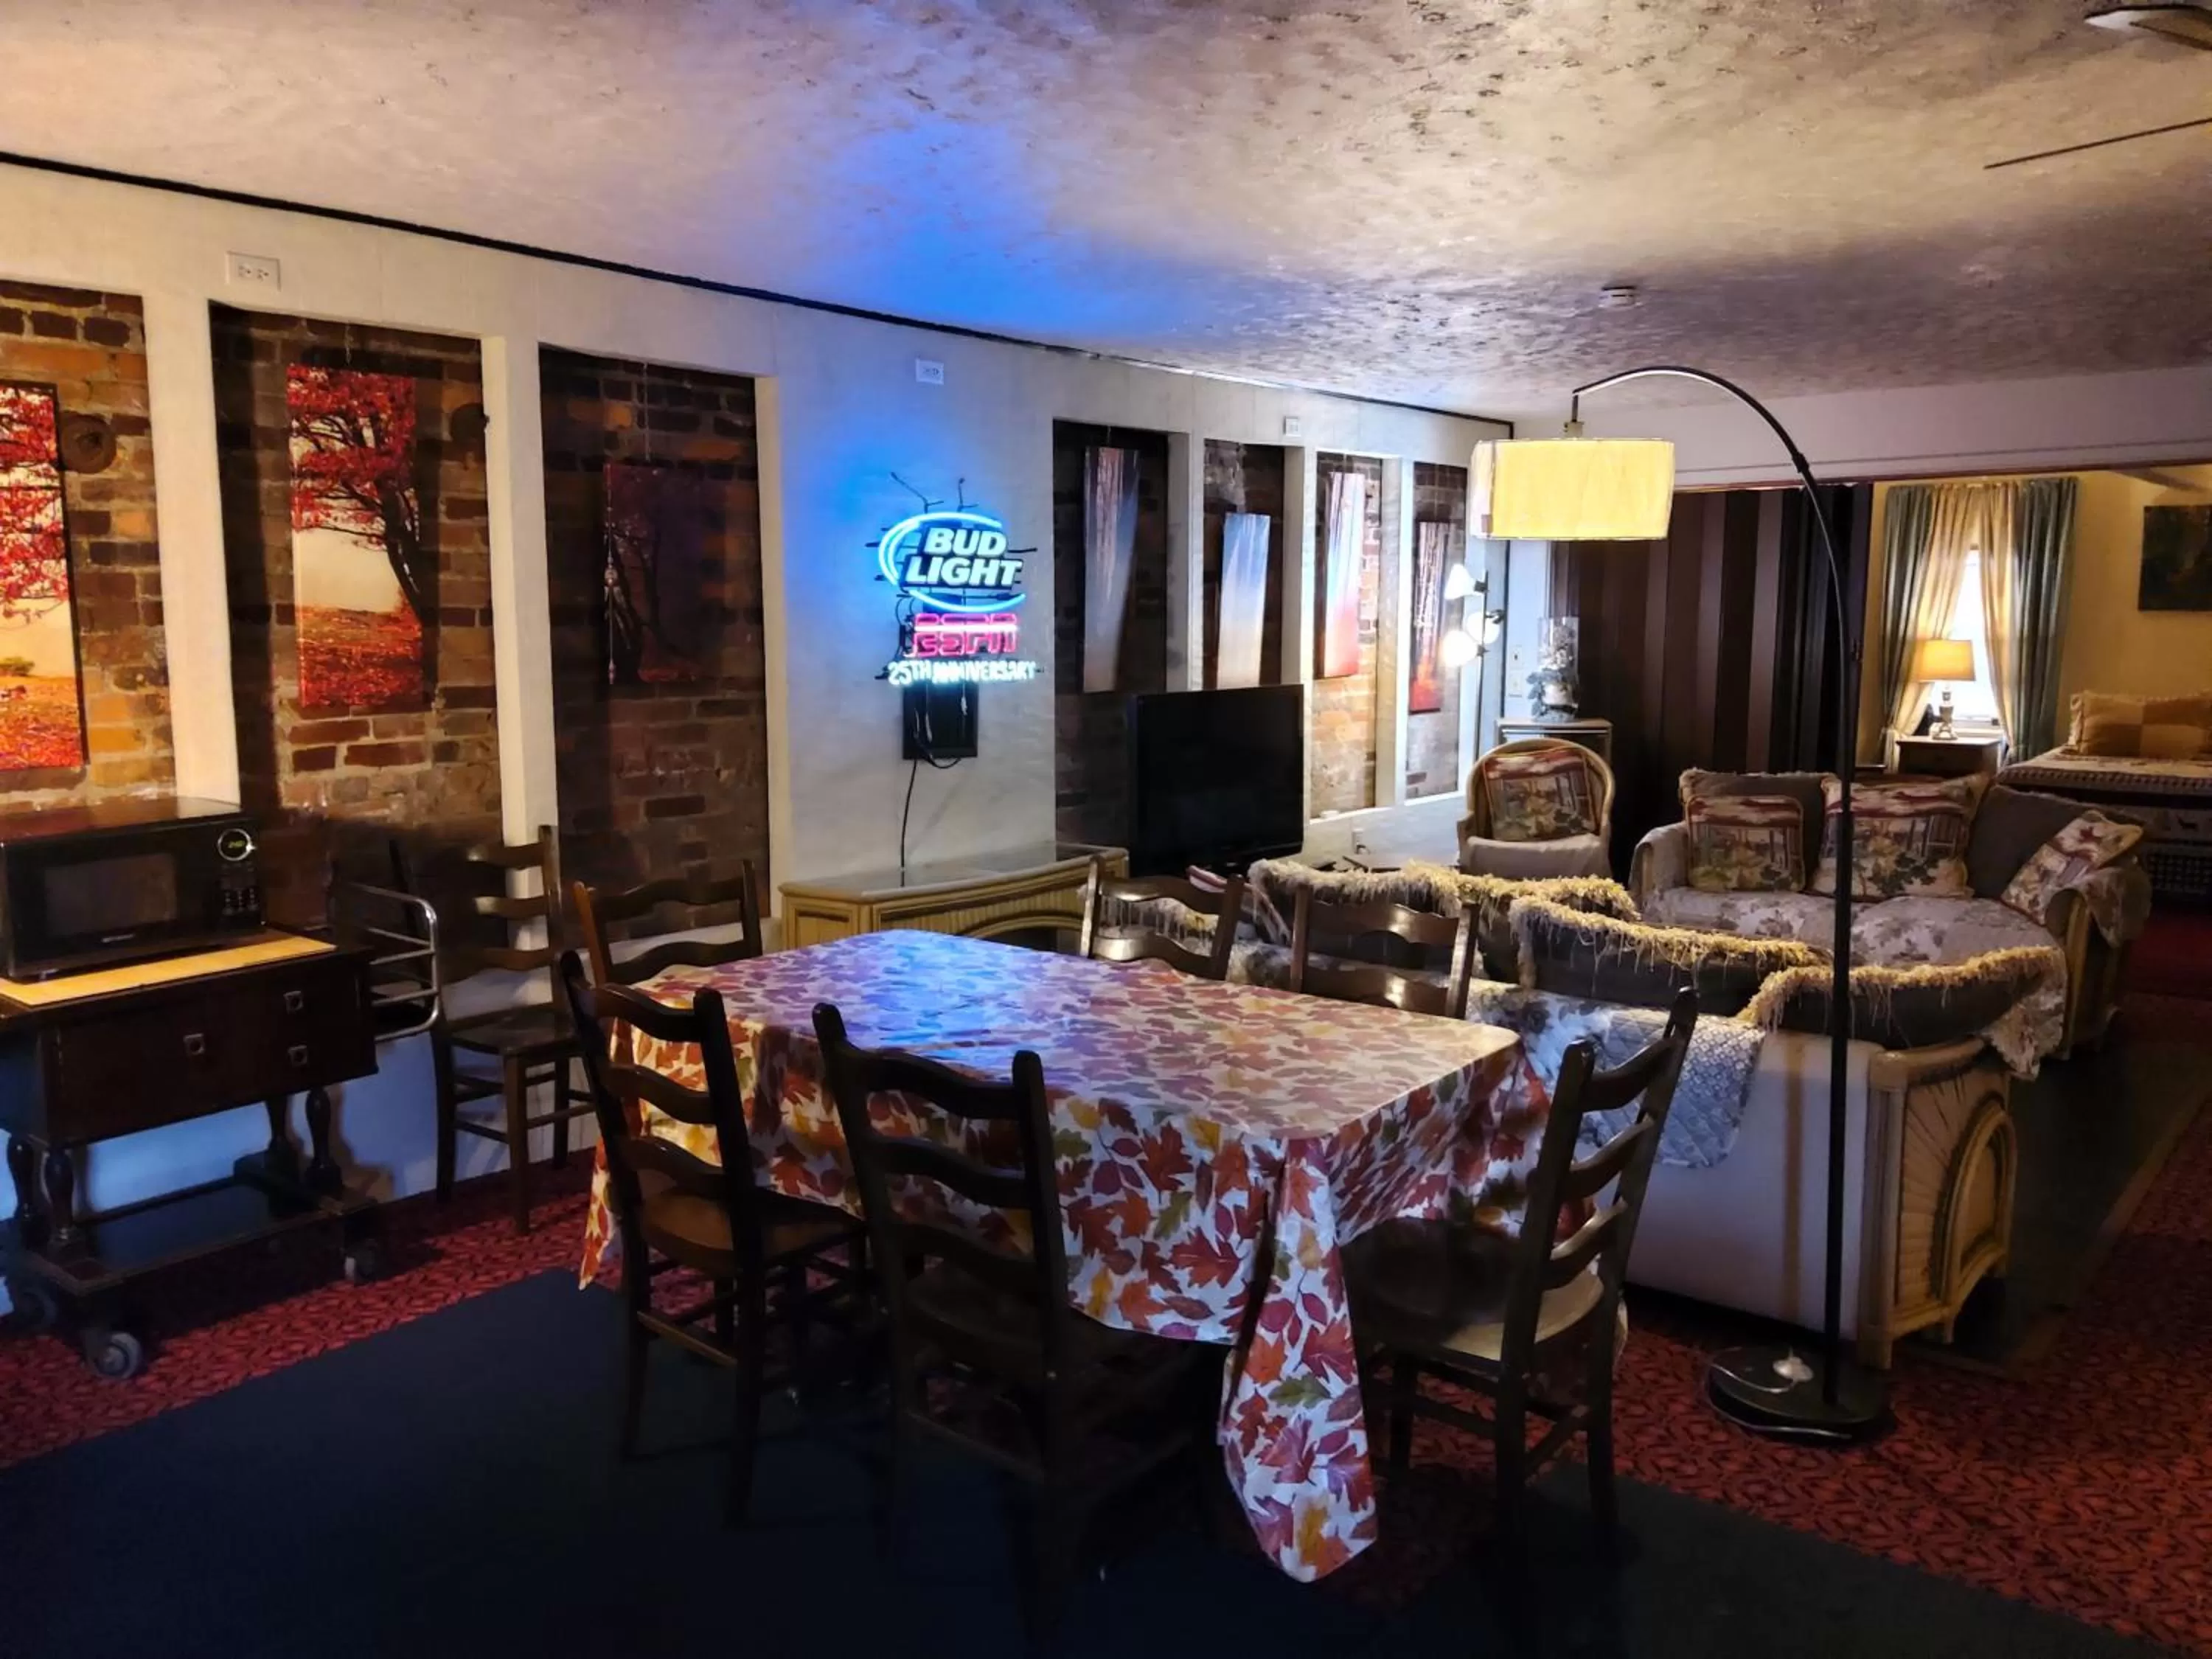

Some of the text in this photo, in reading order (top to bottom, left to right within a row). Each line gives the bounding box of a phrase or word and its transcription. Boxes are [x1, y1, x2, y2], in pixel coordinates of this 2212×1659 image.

[923, 527, 1008, 558] BUD
[905, 557, 1024, 587] LIGHT
[914, 613, 1018, 656] ESPN
[888, 659, 1037, 686] 25TH ANNIVERSARY
